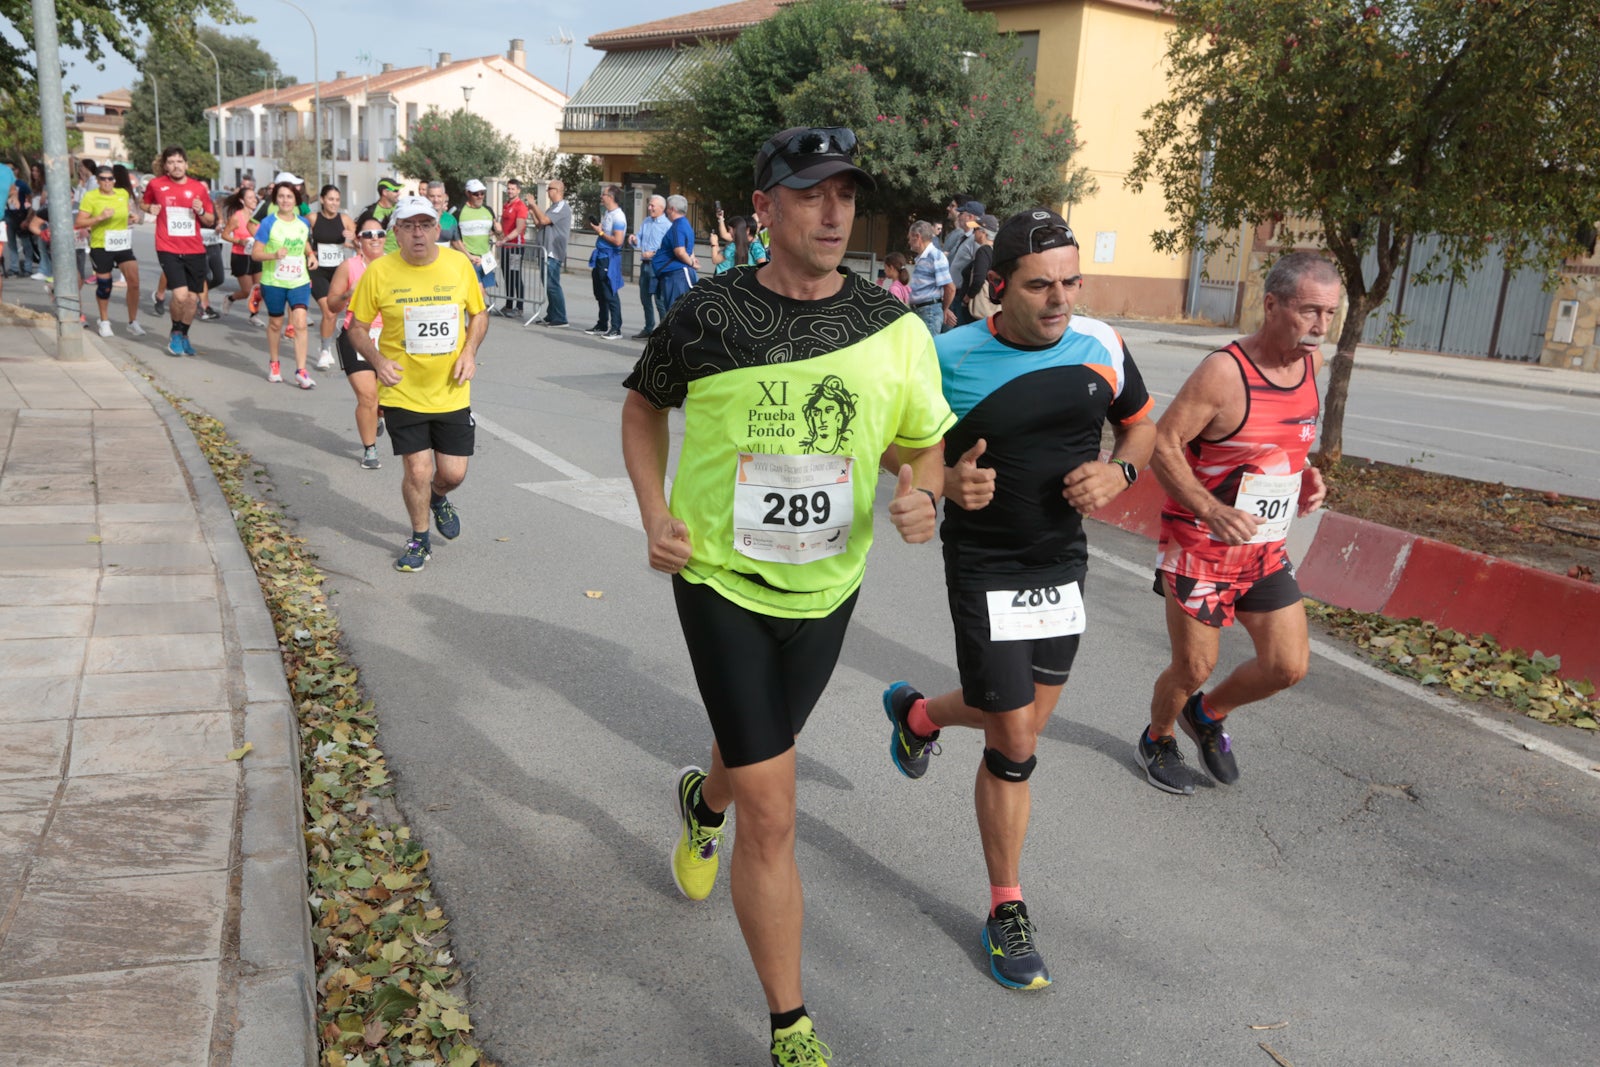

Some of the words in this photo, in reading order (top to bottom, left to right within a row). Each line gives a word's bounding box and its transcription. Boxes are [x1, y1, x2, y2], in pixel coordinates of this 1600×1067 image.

[171, 221, 192, 230] 3059
[108, 238, 127, 246] 3001
[279, 263, 302, 274] 2126
[418, 321, 449, 337] 256
[755, 381, 789, 406] XI
[748, 408, 795, 421] Prueba
[747, 423, 795, 438] Fondo
[762, 490, 831, 527] 289
[1254, 498, 1290, 520] 301
